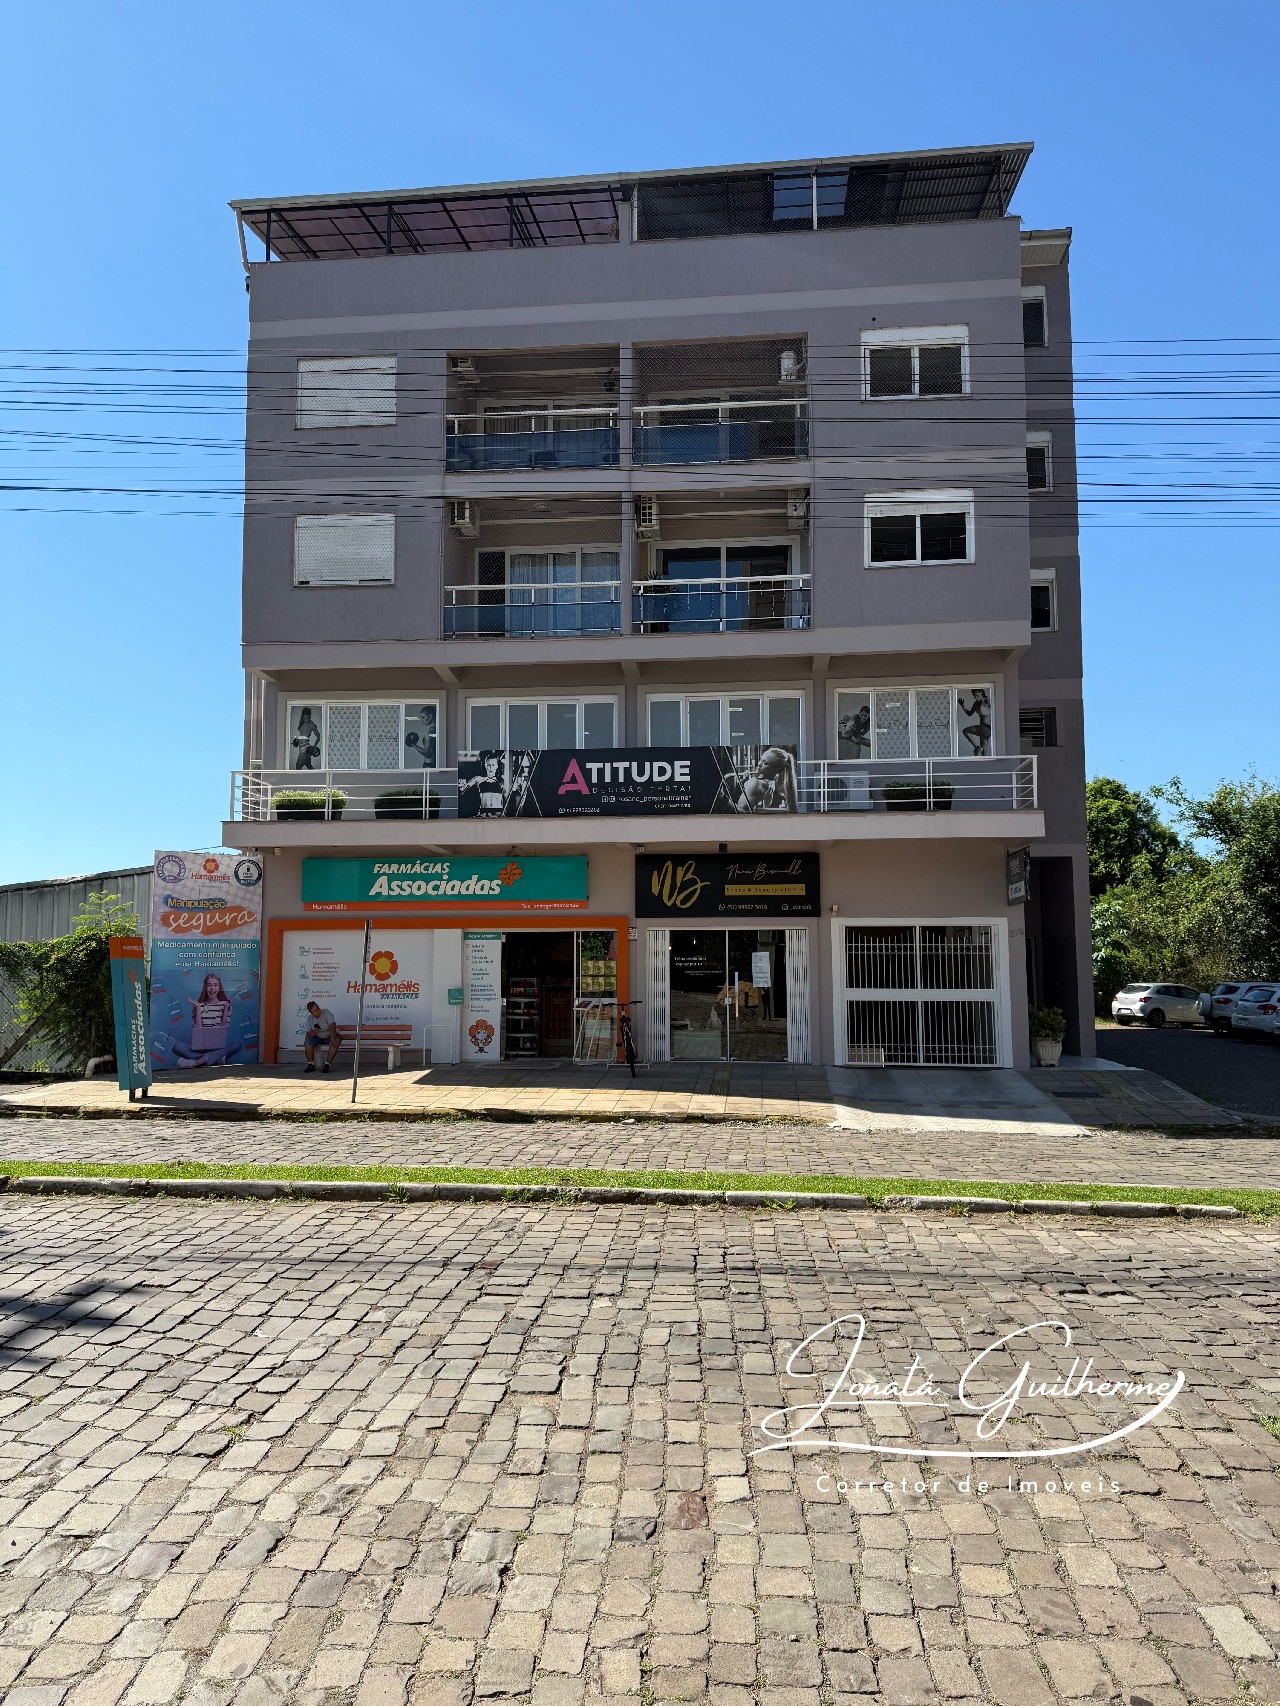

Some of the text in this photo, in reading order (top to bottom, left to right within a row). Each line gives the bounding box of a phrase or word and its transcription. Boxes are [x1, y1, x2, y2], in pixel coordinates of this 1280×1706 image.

[558, 758, 691, 795] ATITUDE
[373, 860, 450, 874] FARMÁCIAS
[369, 874, 502, 896] Associadas
[168, 898, 226, 909] Manipulação
[168, 910, 258, 933] segura
[157, 941, 257, 950] Medicamento manipulado
[198, 951, 236, 959] confiança
[134, 981, 147, 1076] Associadas
